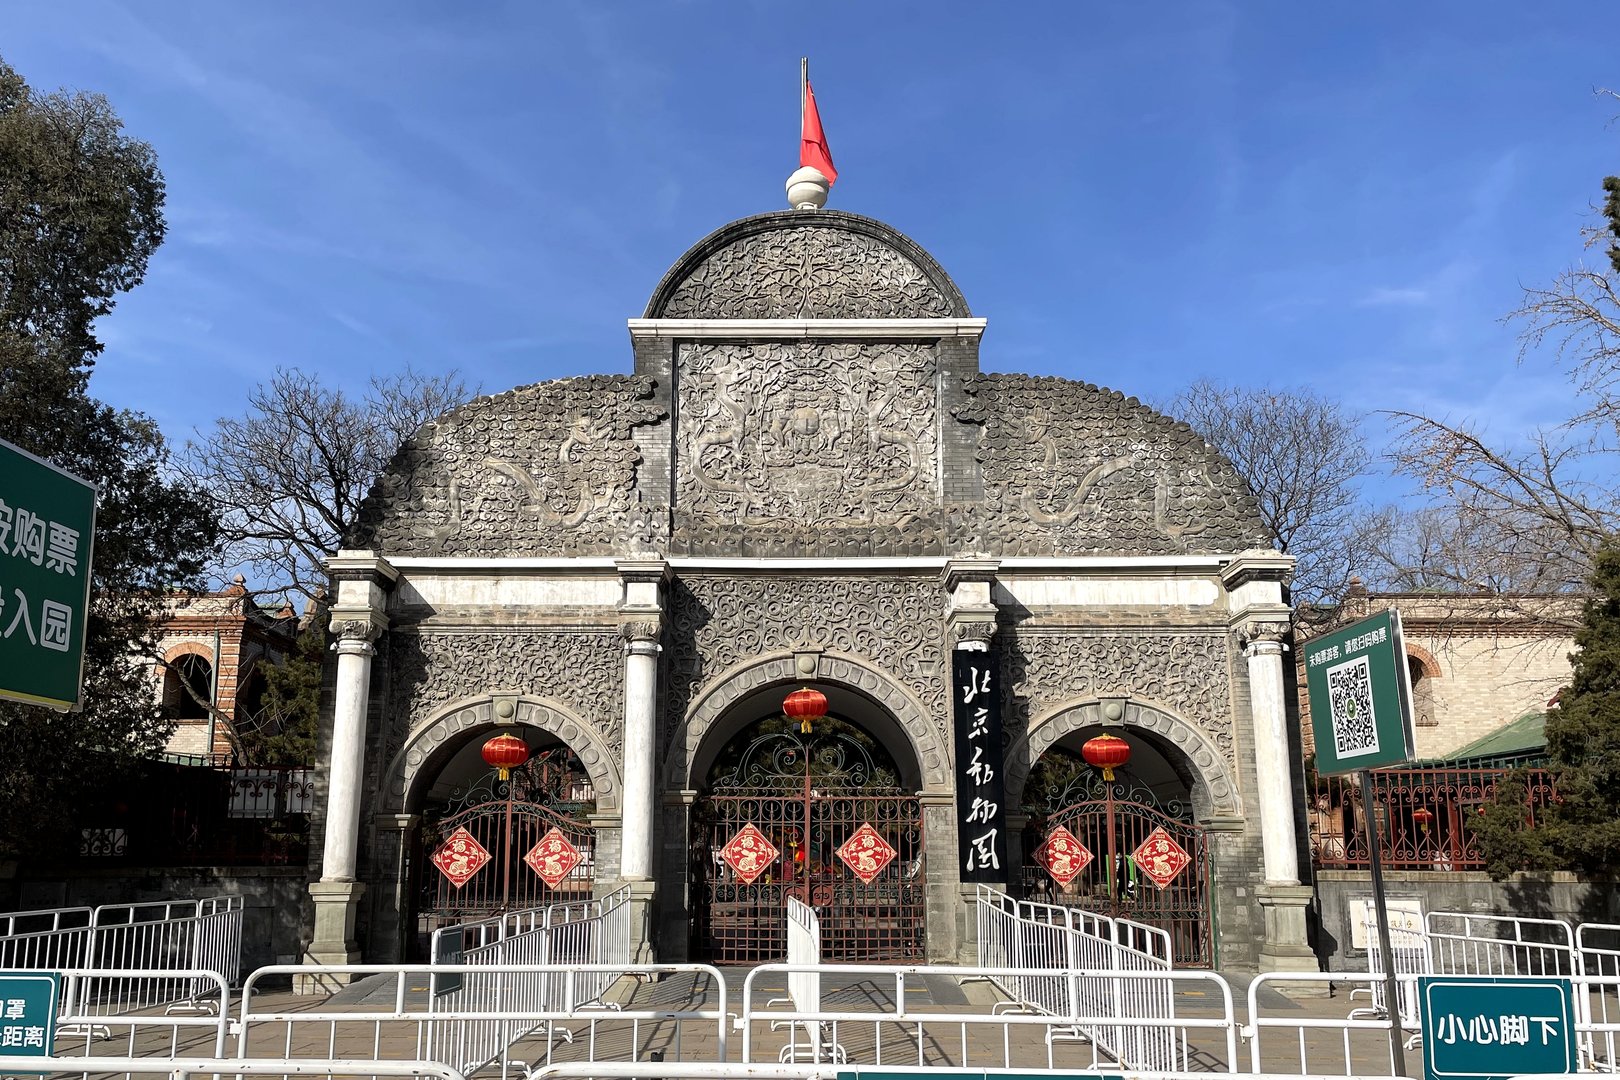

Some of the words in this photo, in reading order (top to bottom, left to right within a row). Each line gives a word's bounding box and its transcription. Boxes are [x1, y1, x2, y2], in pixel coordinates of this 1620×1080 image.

[0, 585, 73, 652] 入园
[452, 840, 466, 852] 福
[548, 840, 562, 852] 福
[741, 836, 755, 848] 福
[861, 835, 875, 848] 福
[1053, 839, 1068, 851] 福
[1155, 840, 1169, 853] 福
[0, 999, 25, 1020] 罩
[0, 1025, 45, 1047] 距离
[1437, 1014, 1559, 1045] 小心脚下
